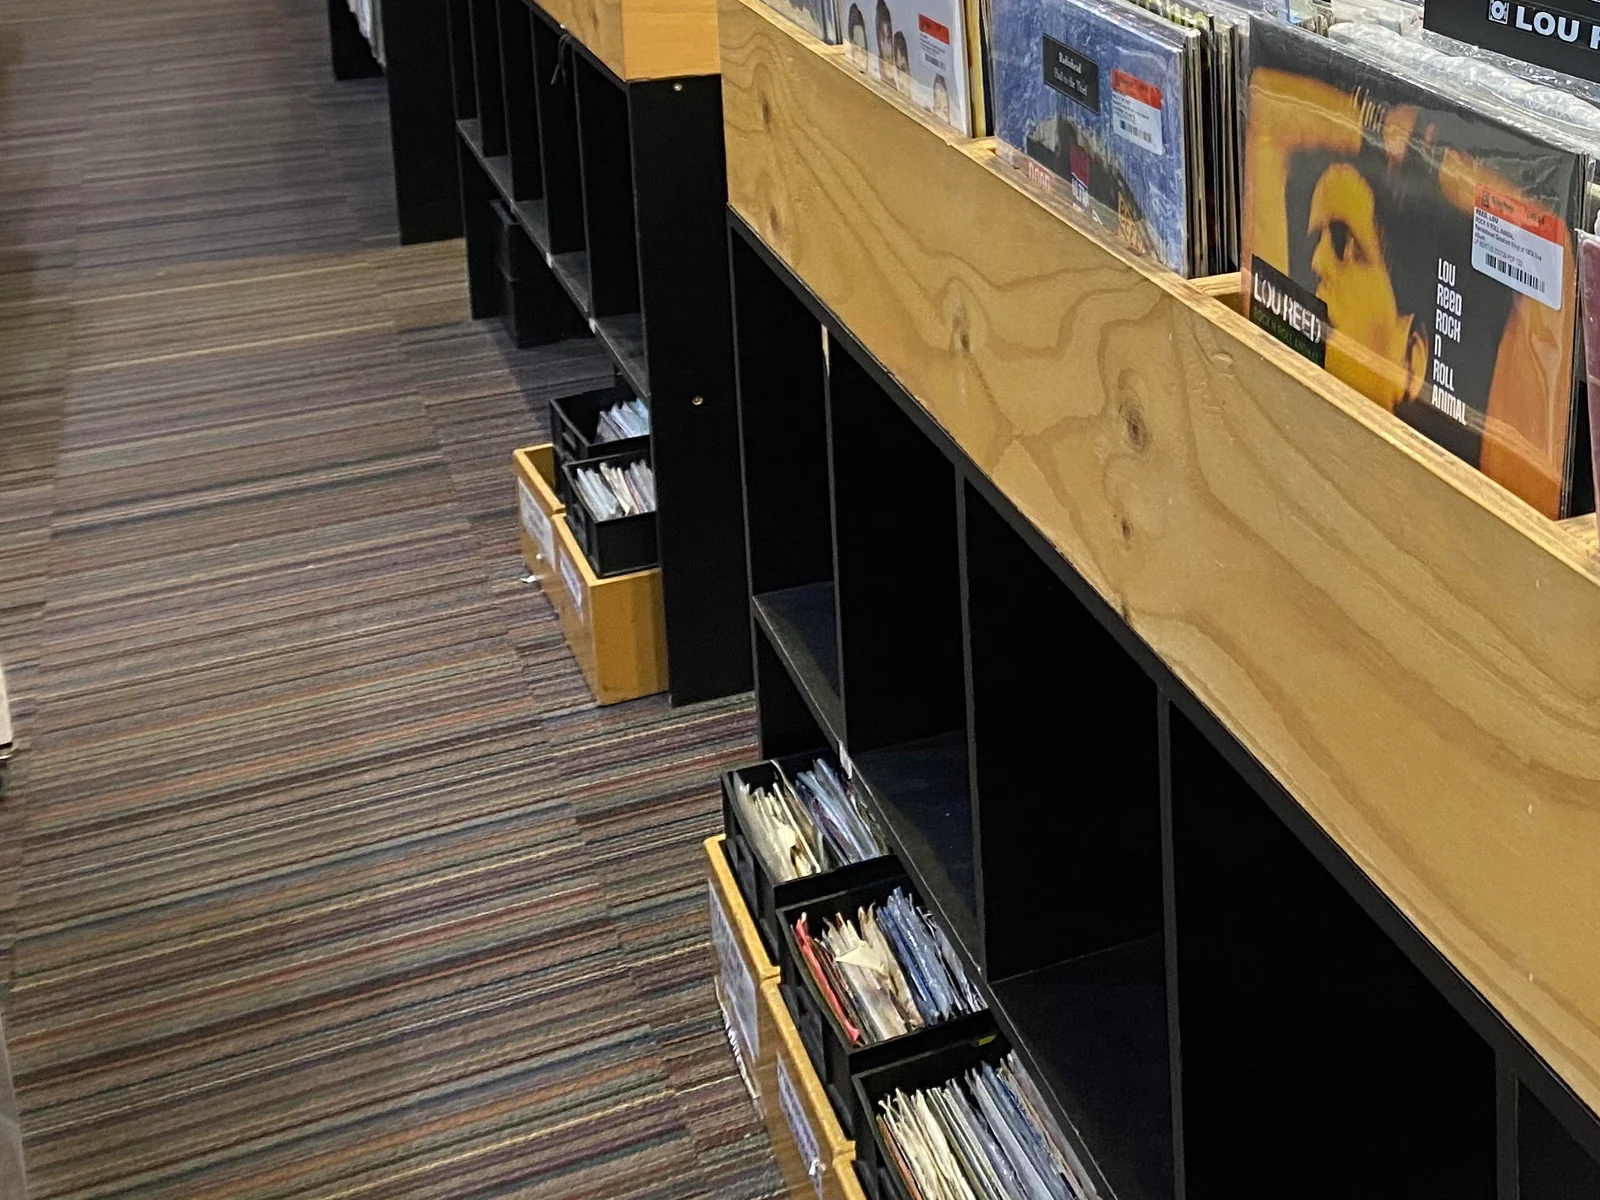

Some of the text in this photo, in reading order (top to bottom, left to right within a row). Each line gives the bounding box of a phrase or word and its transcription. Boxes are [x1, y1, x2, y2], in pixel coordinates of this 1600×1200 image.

[1515, 5, 1579, 44] LOU
[1438, 258, 1456, 287] LOU
[1254, 271, 1322, 343] LOU REED
[1436, 308, 1461, 343] ROCK
[1433, 359, 1455, 392] ROLL
